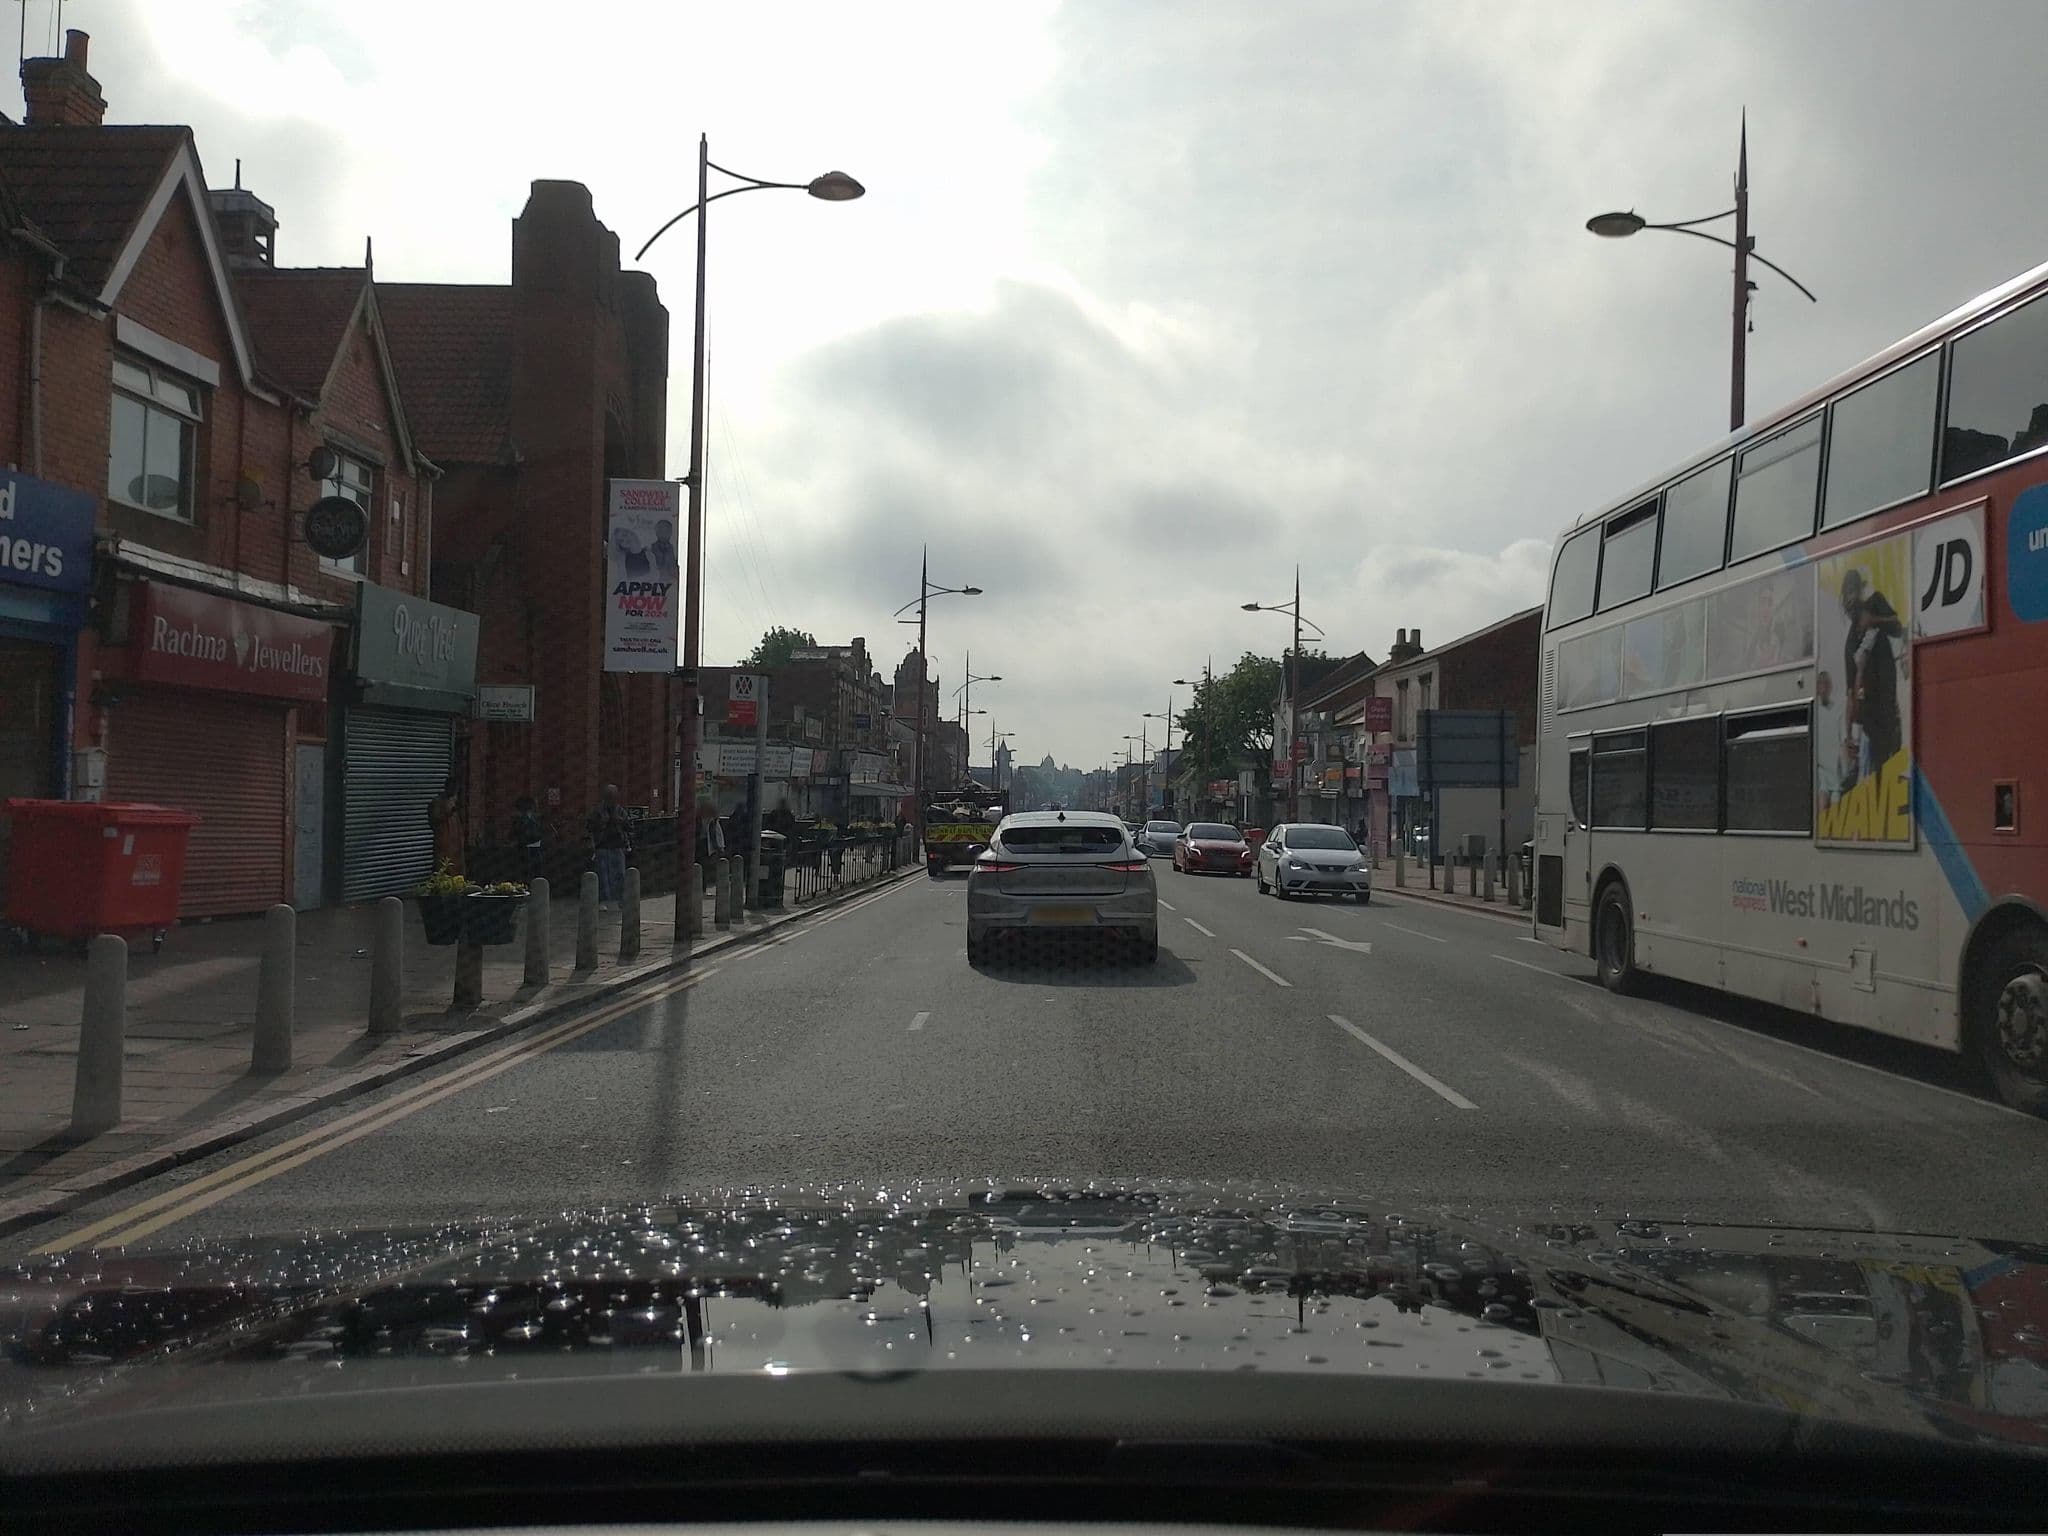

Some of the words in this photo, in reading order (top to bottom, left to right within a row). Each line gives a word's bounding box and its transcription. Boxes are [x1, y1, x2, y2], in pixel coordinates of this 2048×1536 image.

[620, 488, 672, 500] SANDWELL
[624, 497, 666, 507] COLLEGE
[1921, 538, 1972, 612] JD
[613, 581, 672, 597] APPLY
[618, 596, 668, 610] NOW
[625, 609, 643, 617] FOR
[644, 610, 668, 618] 2024
[152, 615, 227, 662] Rachna
[249, 635, 323, 678] Jewellers
[612, 645, 668, 654] sandwell.ac.uk
[1732, 895, 1768, 913] express
[1732, 878, 1767, 896] national
[1768, 879, 1816, 918] West
[1820, 883, 1919, 932] Midlands
